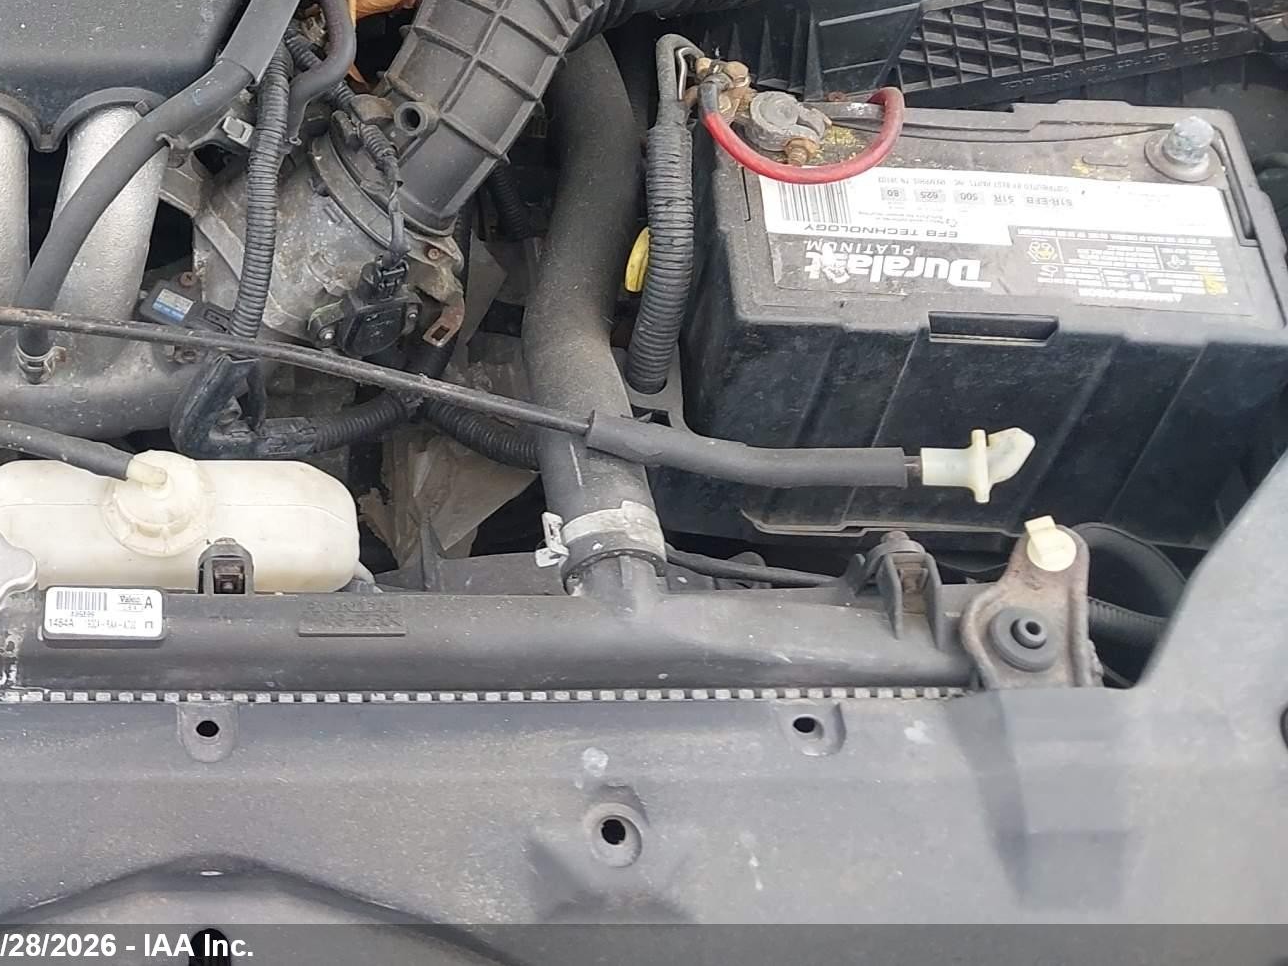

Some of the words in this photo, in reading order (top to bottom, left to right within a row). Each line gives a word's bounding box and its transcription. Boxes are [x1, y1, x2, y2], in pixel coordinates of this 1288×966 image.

[803, 224, 918, 236] TECHNOLOGY
[926, 229, 959, 239] EFB
[144, 596, 153, 609] A
